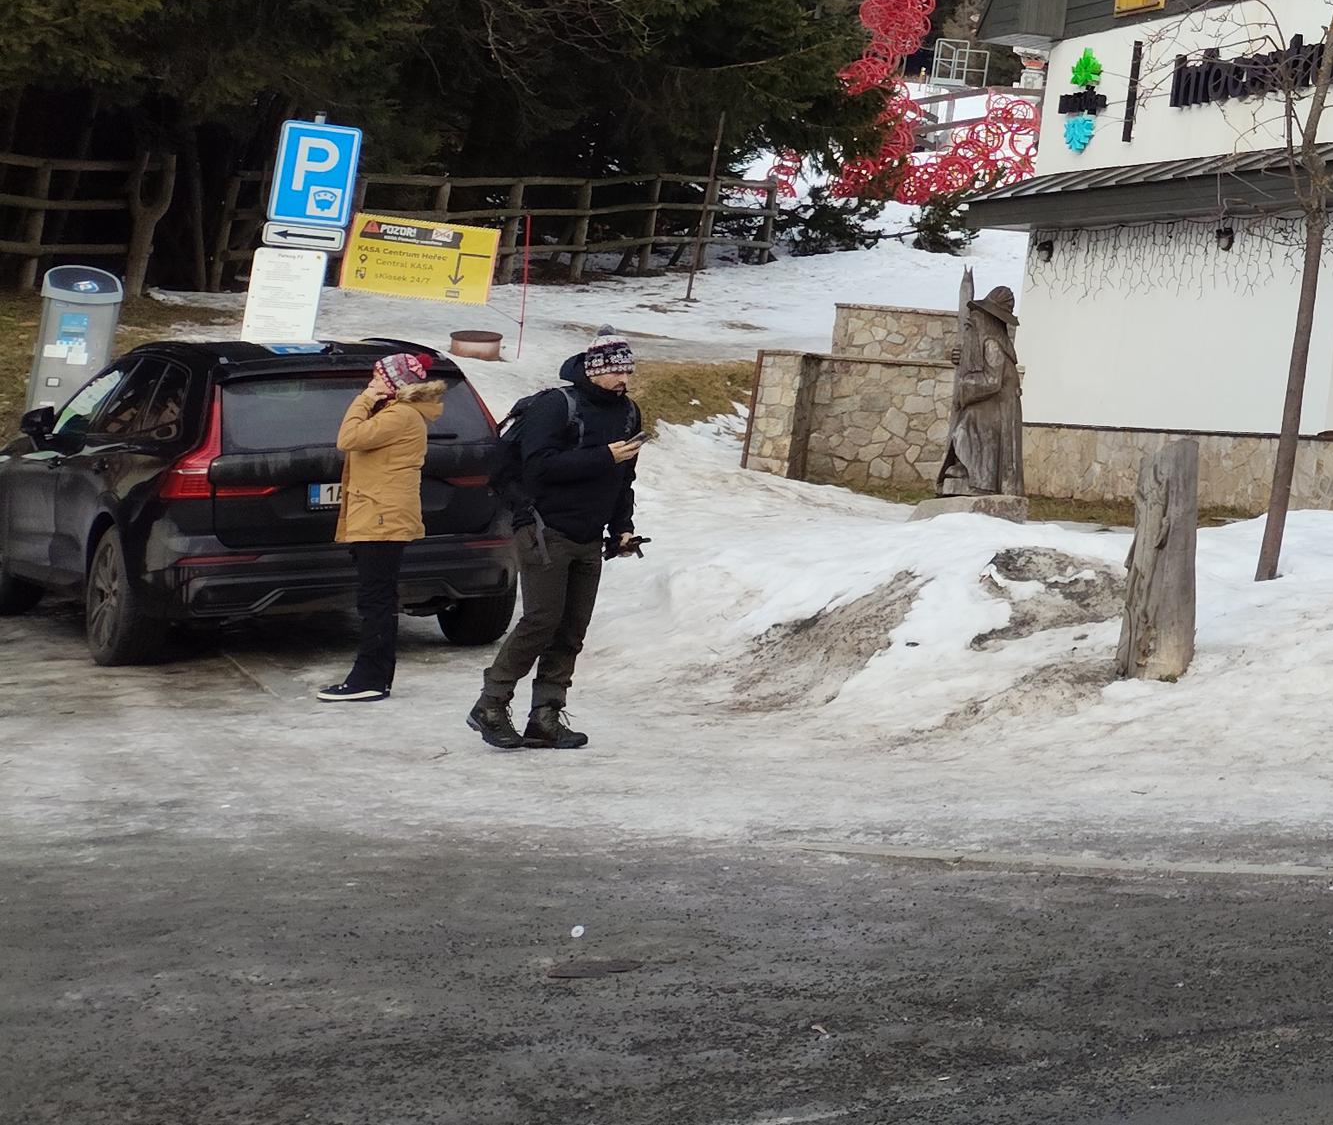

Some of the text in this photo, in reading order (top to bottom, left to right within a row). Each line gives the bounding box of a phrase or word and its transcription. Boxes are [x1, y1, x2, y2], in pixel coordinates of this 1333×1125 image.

[291, 135, 340, 191] P
[380, 224, 417, 238] POZOR!
[357, 245, 448, 261] KASA Centrum Hořec
[376, 258, 434, 271] Central KASA
